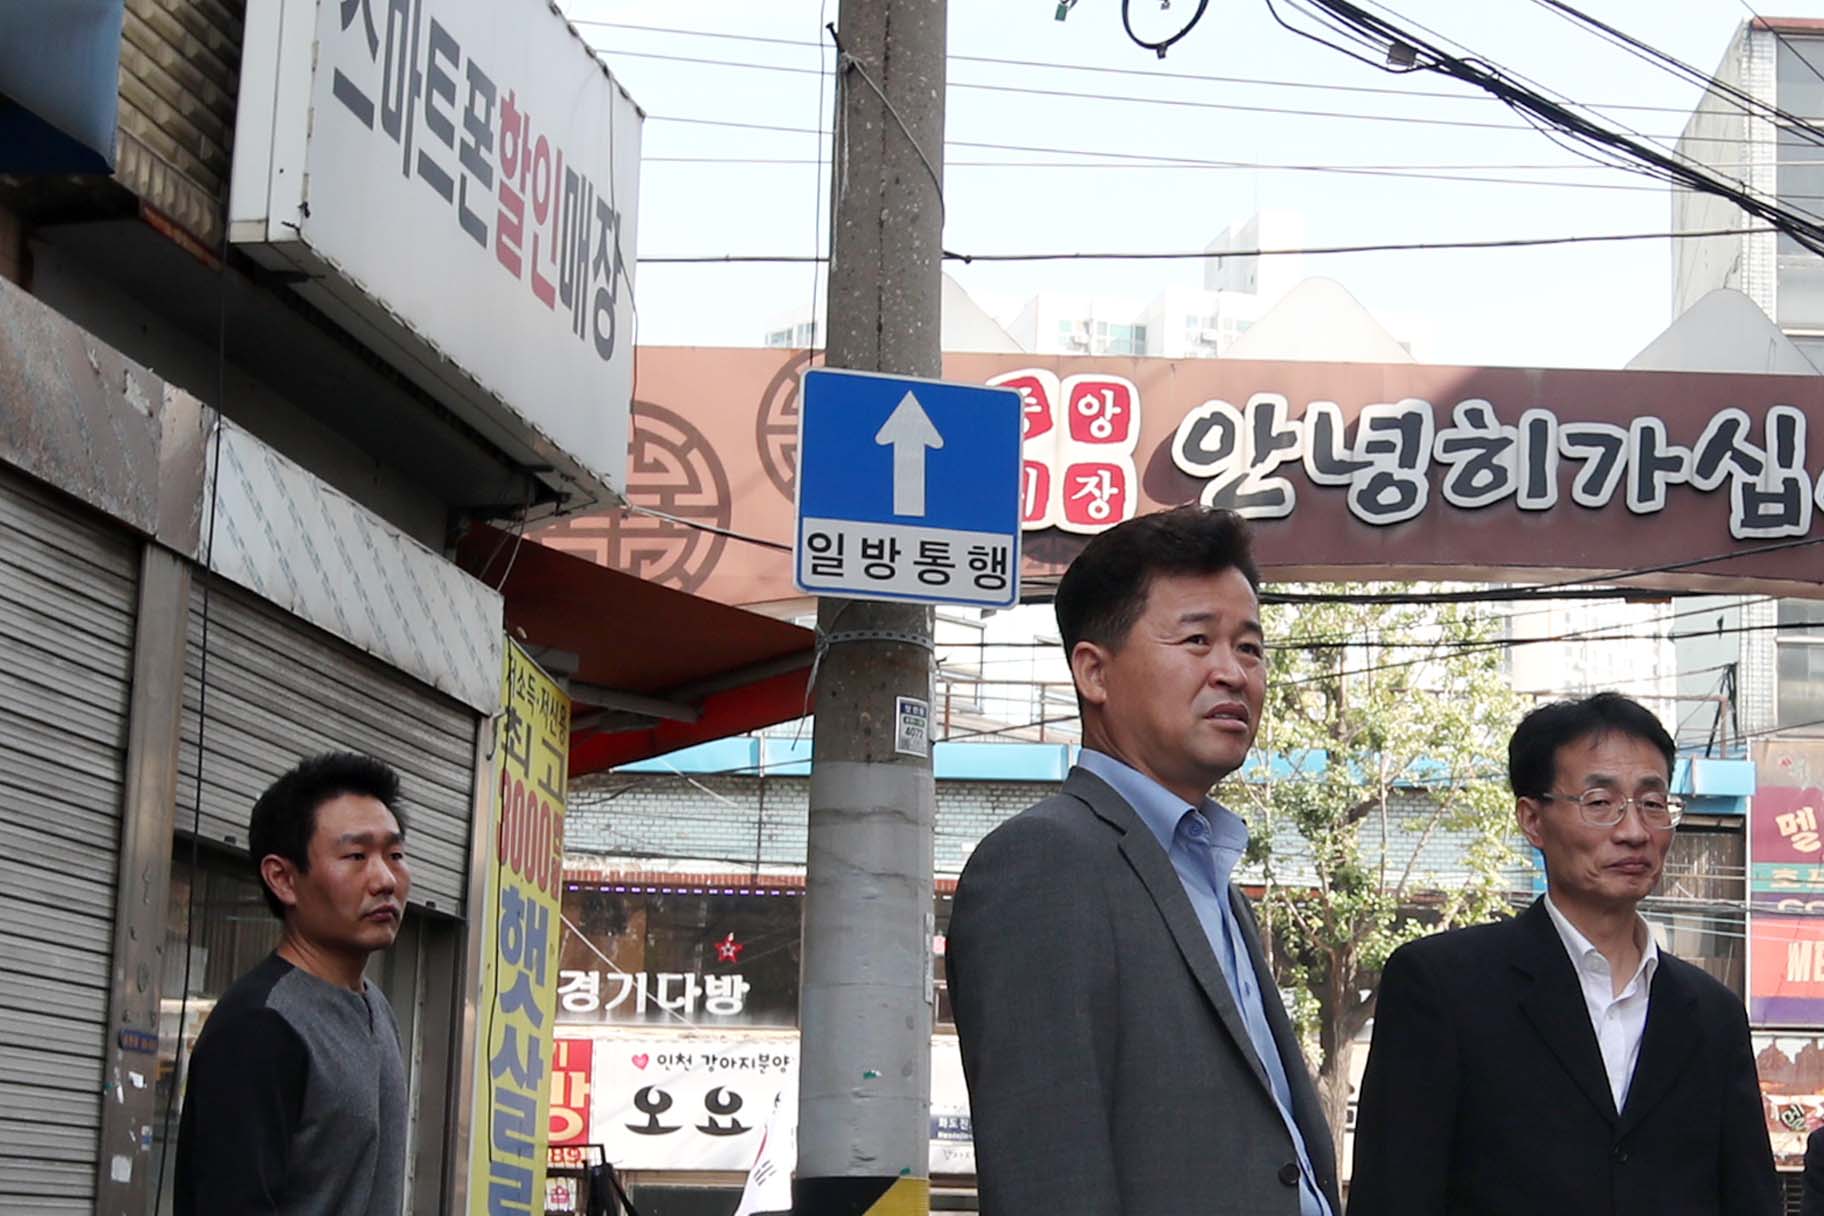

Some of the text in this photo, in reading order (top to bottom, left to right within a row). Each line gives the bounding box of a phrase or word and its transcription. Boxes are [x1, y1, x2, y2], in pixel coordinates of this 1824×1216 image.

[806, 531, 1008, 591] 일방통행
[501, 704, 566, 805] 최고
[557, 970, 751, 1016] 경기다방
[656, 1053, 693, 1072] 인천
[624, 1084, 782, 1137] 오요
